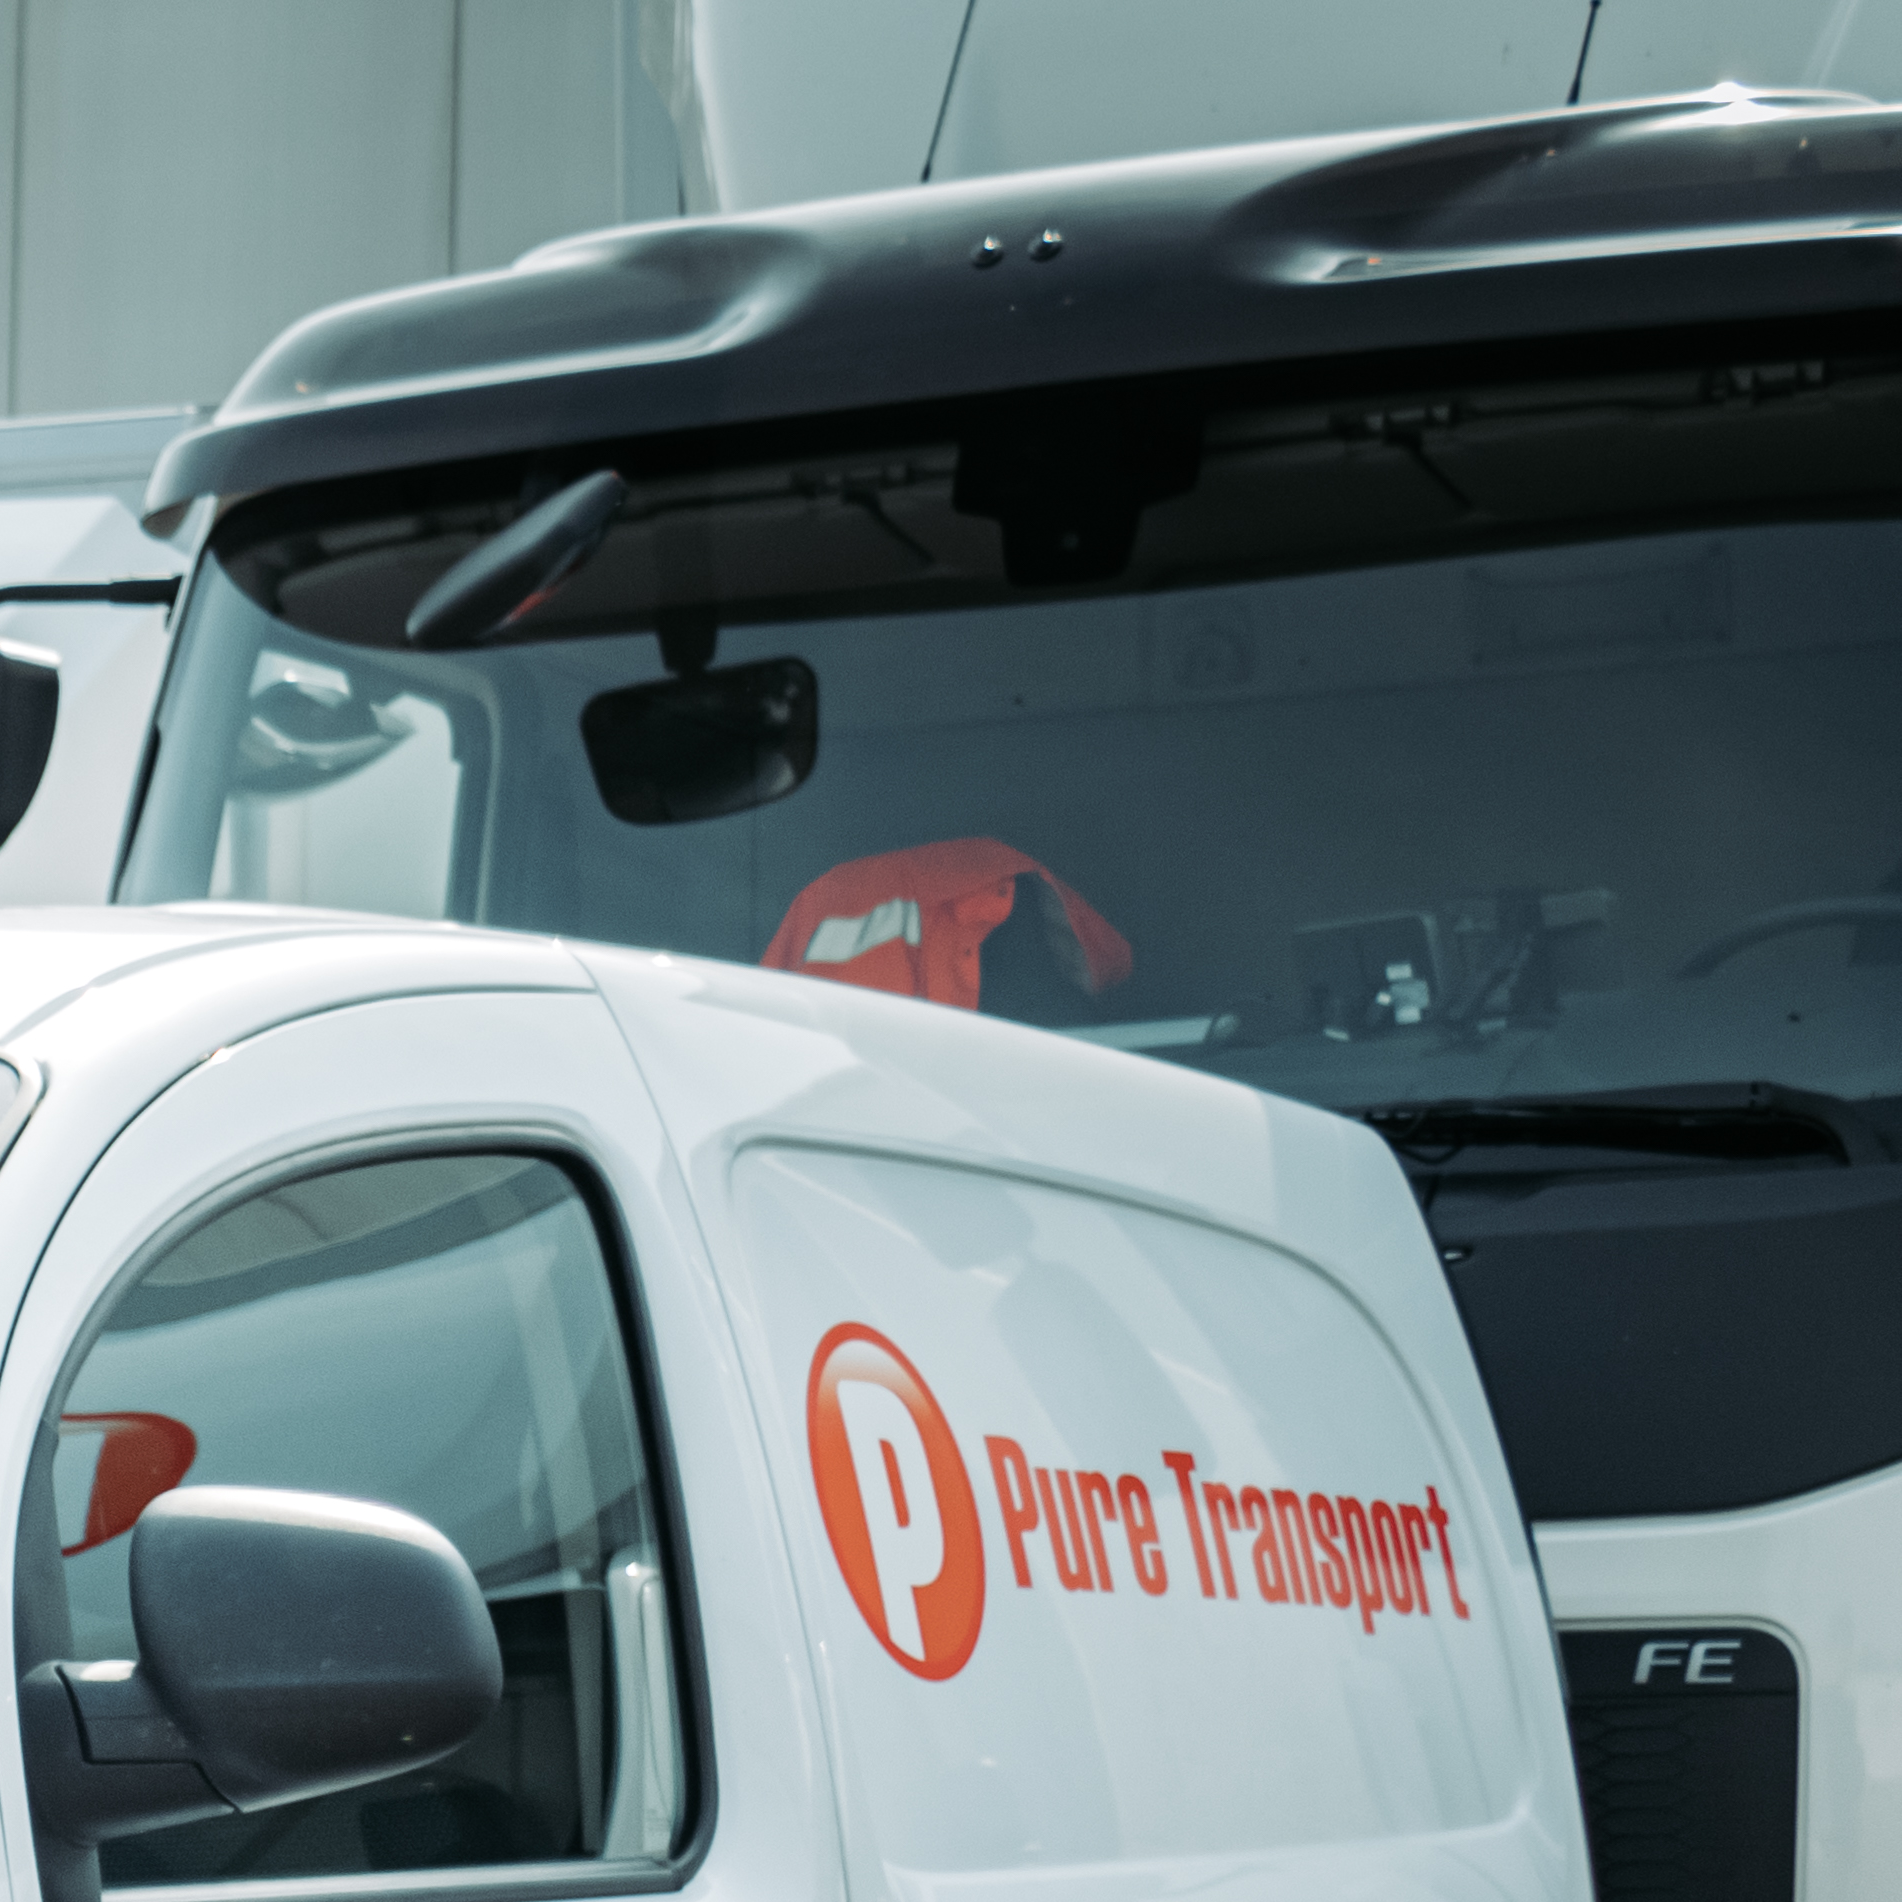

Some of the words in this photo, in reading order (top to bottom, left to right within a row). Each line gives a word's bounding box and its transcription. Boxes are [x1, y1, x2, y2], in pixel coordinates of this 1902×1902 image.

[835, 1377, 946, 1663] P
[983, 1434, 1169, 1597] Pure
[1161, 1449, 1471, 1635] Transport
[1632, 1638, 1742, 1686] FE
